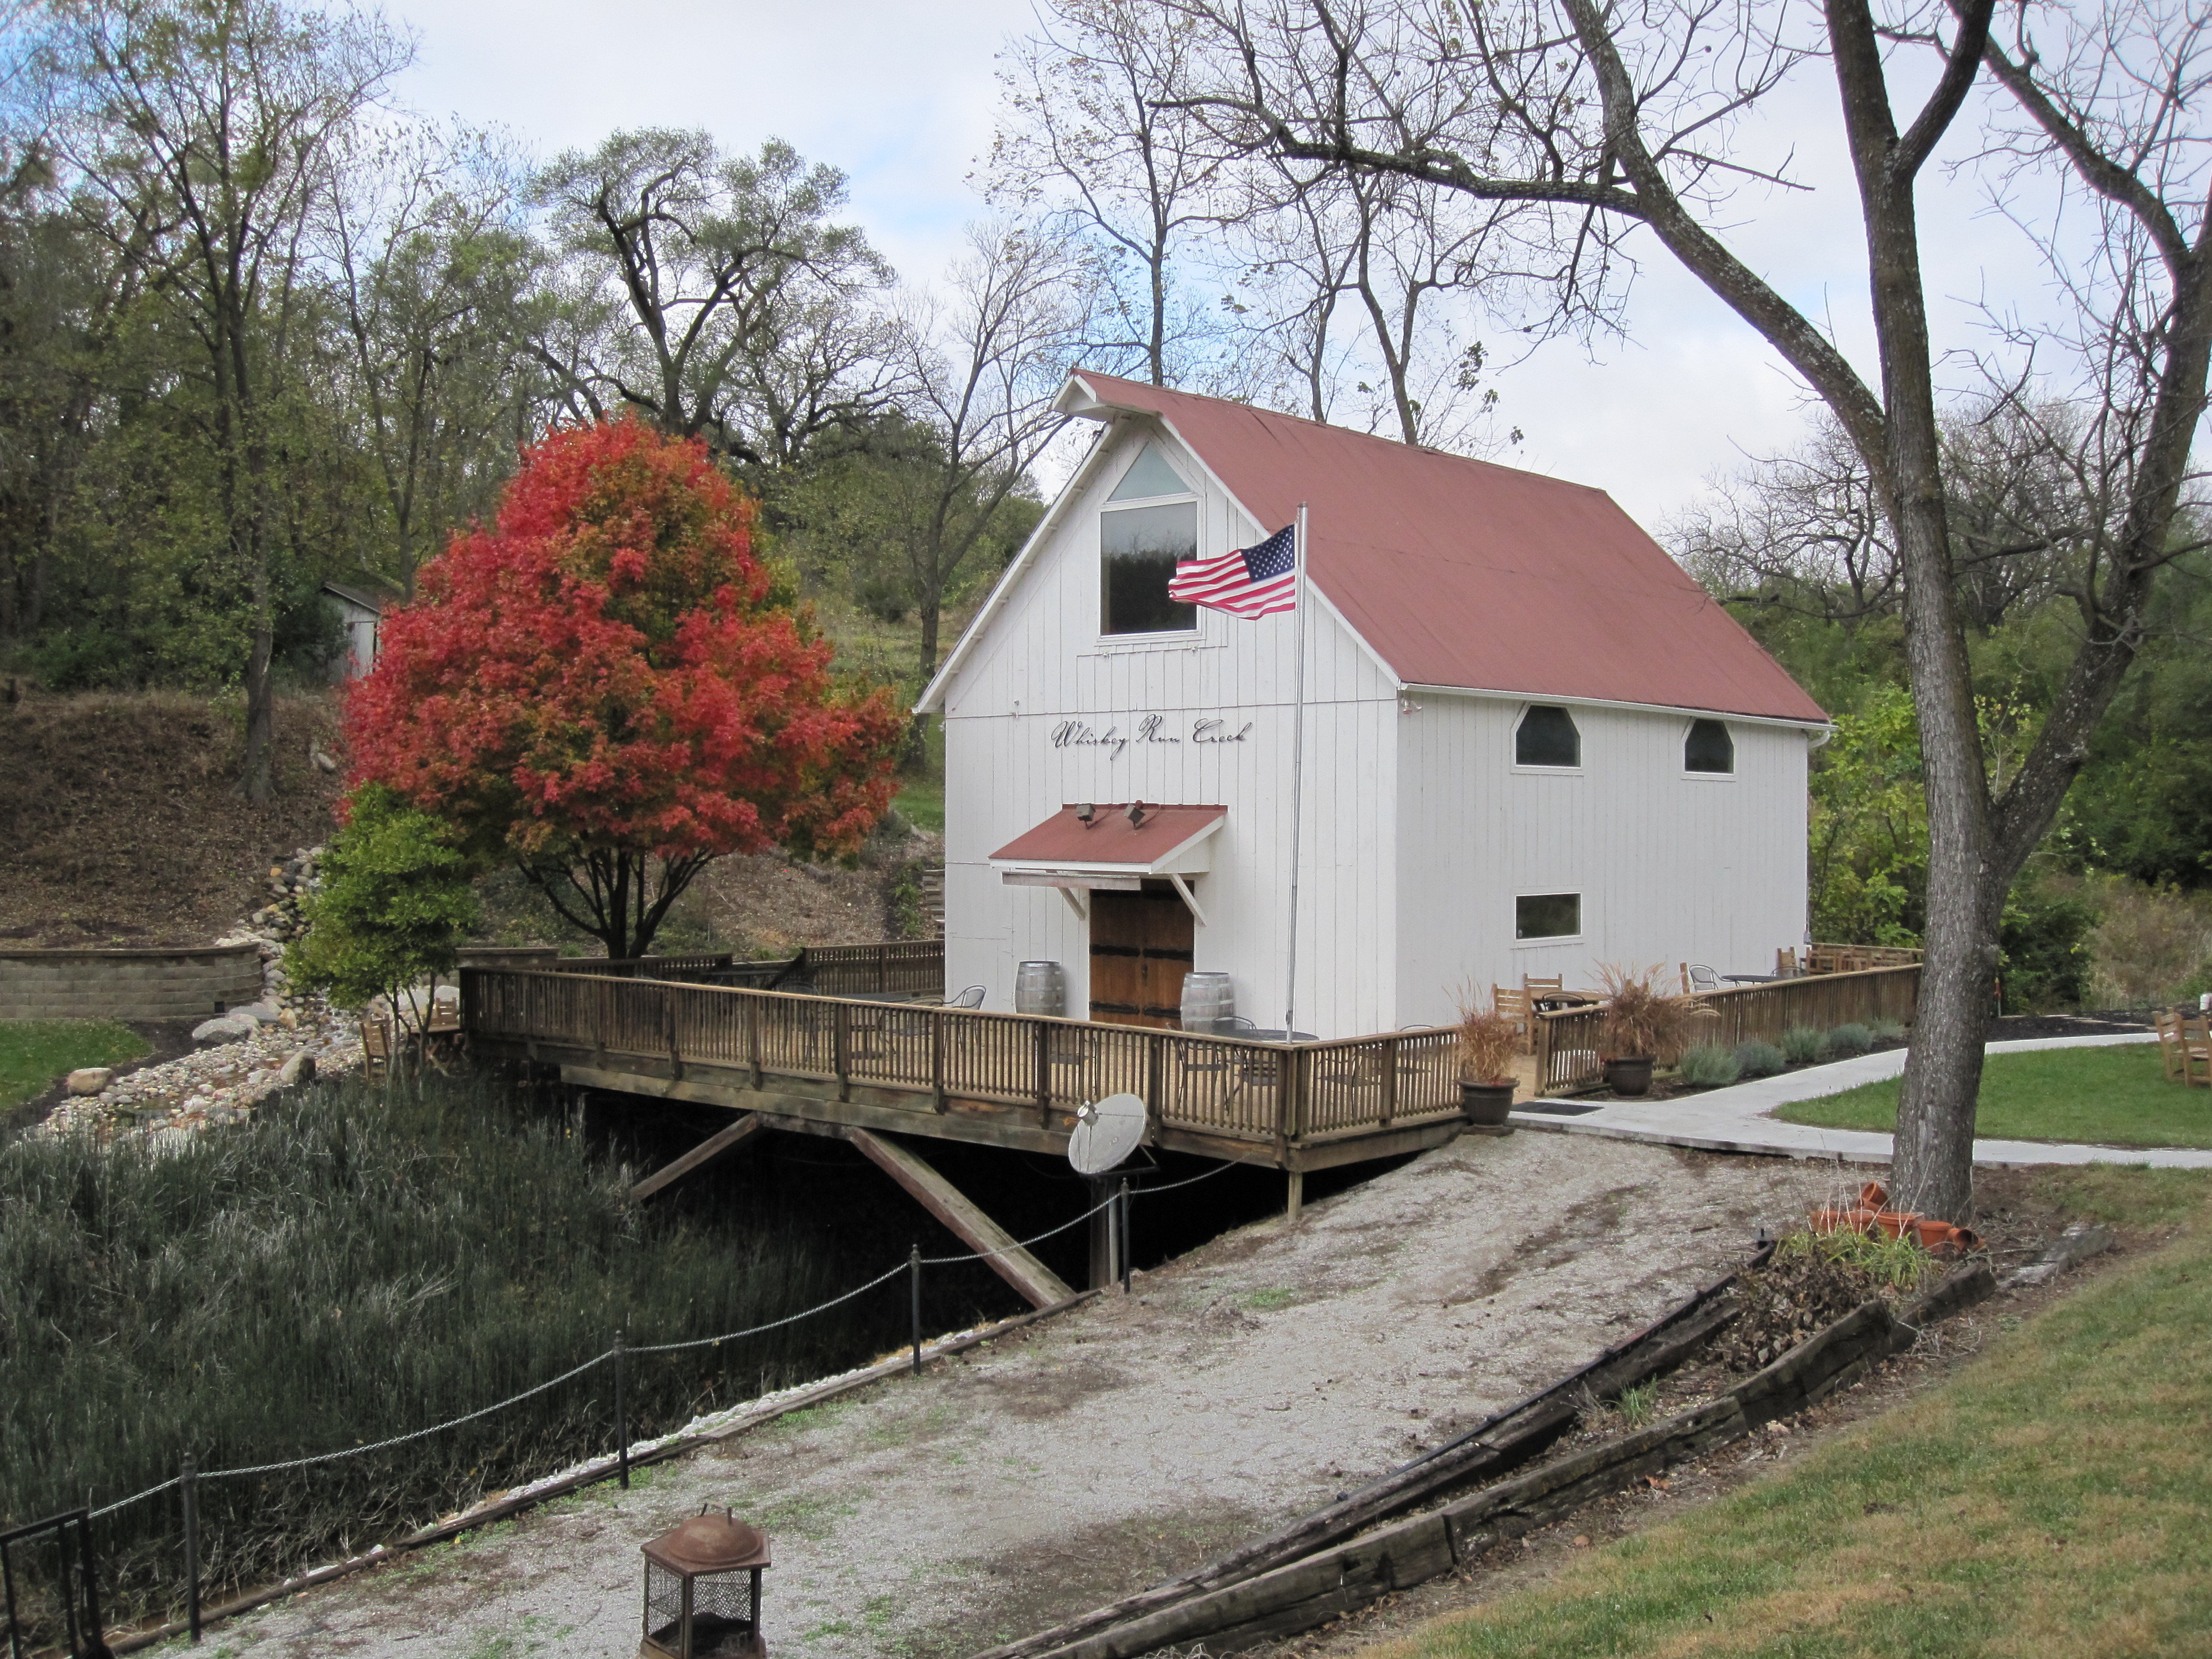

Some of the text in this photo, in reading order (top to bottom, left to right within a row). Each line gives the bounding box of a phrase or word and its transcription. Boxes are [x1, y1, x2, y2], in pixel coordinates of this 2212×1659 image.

[1051, 714, 1253, 761] Whiskey Run Creek
